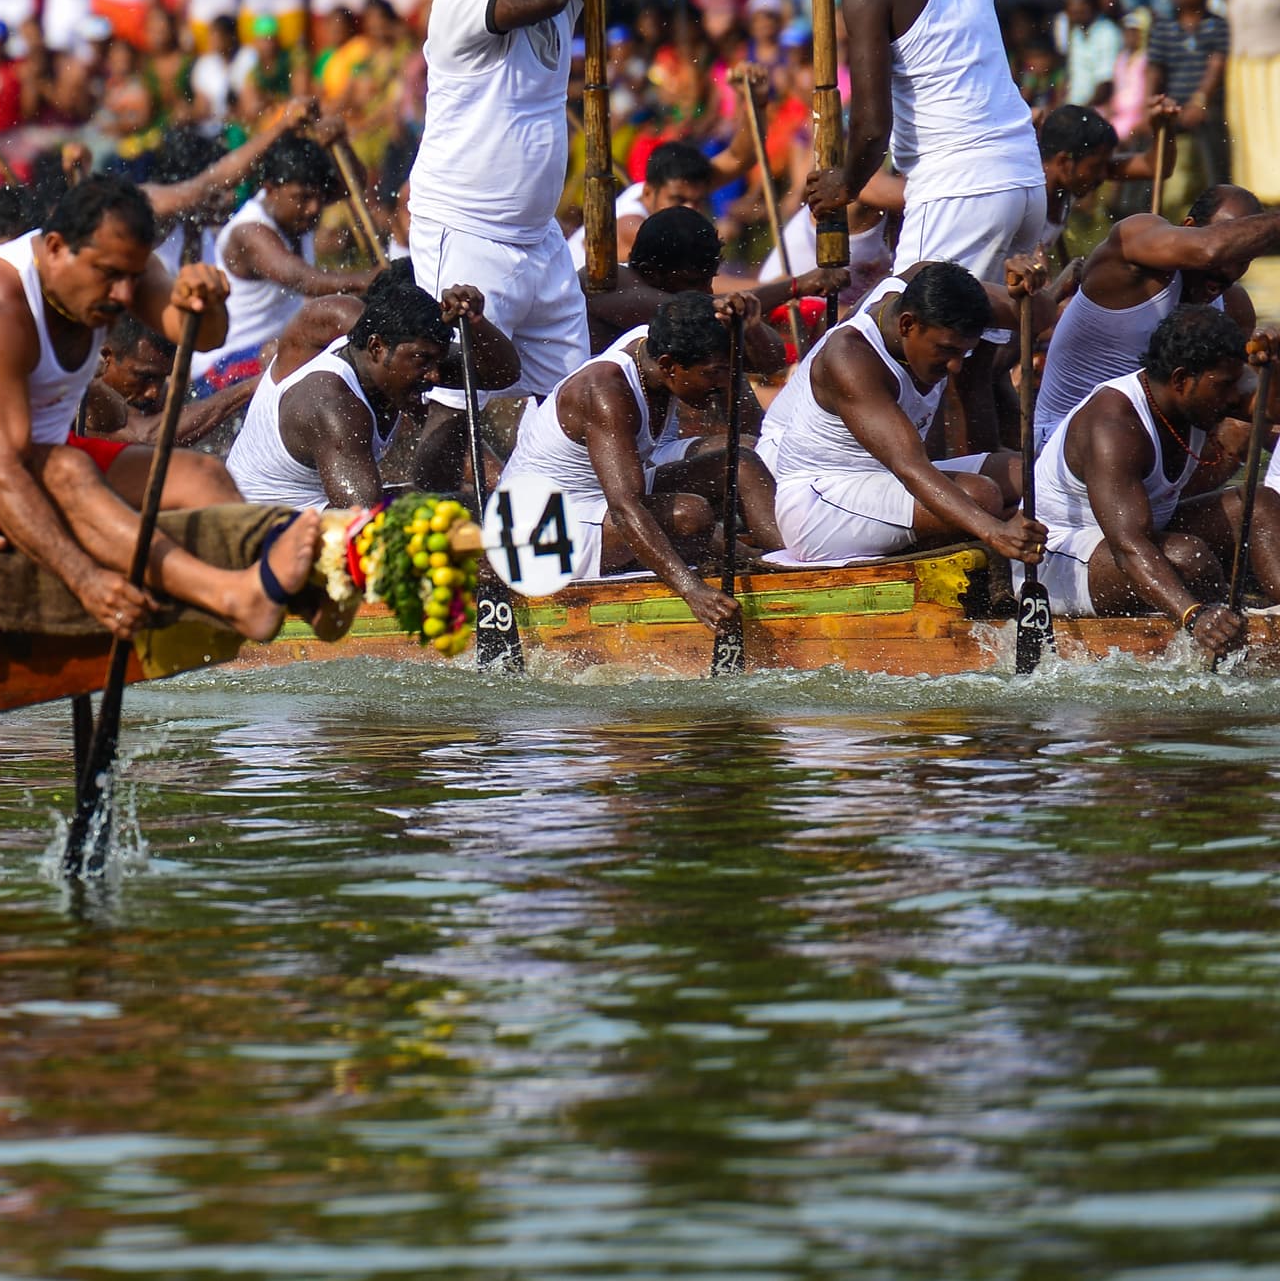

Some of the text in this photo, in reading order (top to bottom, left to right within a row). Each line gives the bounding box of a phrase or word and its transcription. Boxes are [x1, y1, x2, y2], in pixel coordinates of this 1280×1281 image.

[497, 490, 574, 582] 14
[478, 599, 513, 632] 29
[1020, 597, 1050, 630] 25
[715, 644, 742, 673] 27
